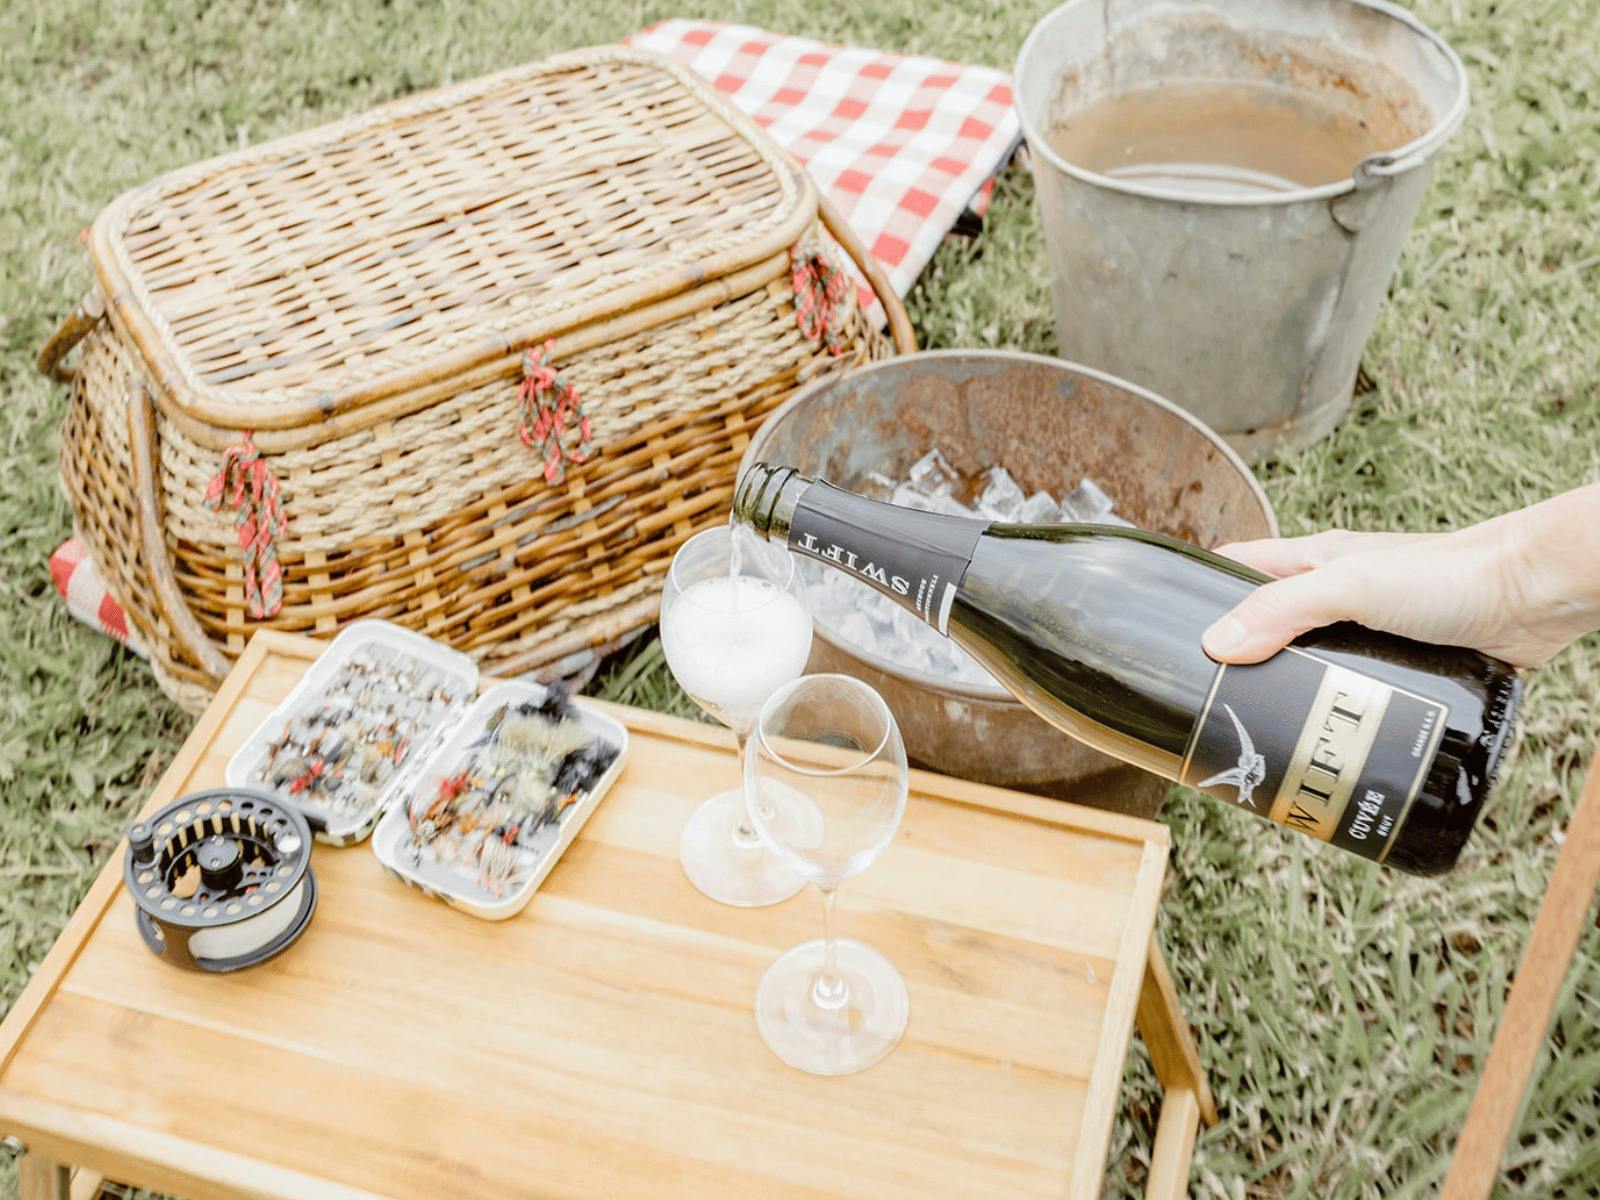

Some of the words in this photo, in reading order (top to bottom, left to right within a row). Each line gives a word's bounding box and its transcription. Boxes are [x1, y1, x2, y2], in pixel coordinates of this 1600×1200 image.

[798, 532, 910, 595] SWIFT
[1284, 691, 1365, 833] WIFT
[1348, 788, 1386, 840] CUVÉE
[1375, 814, 1394, 838] BRUT
